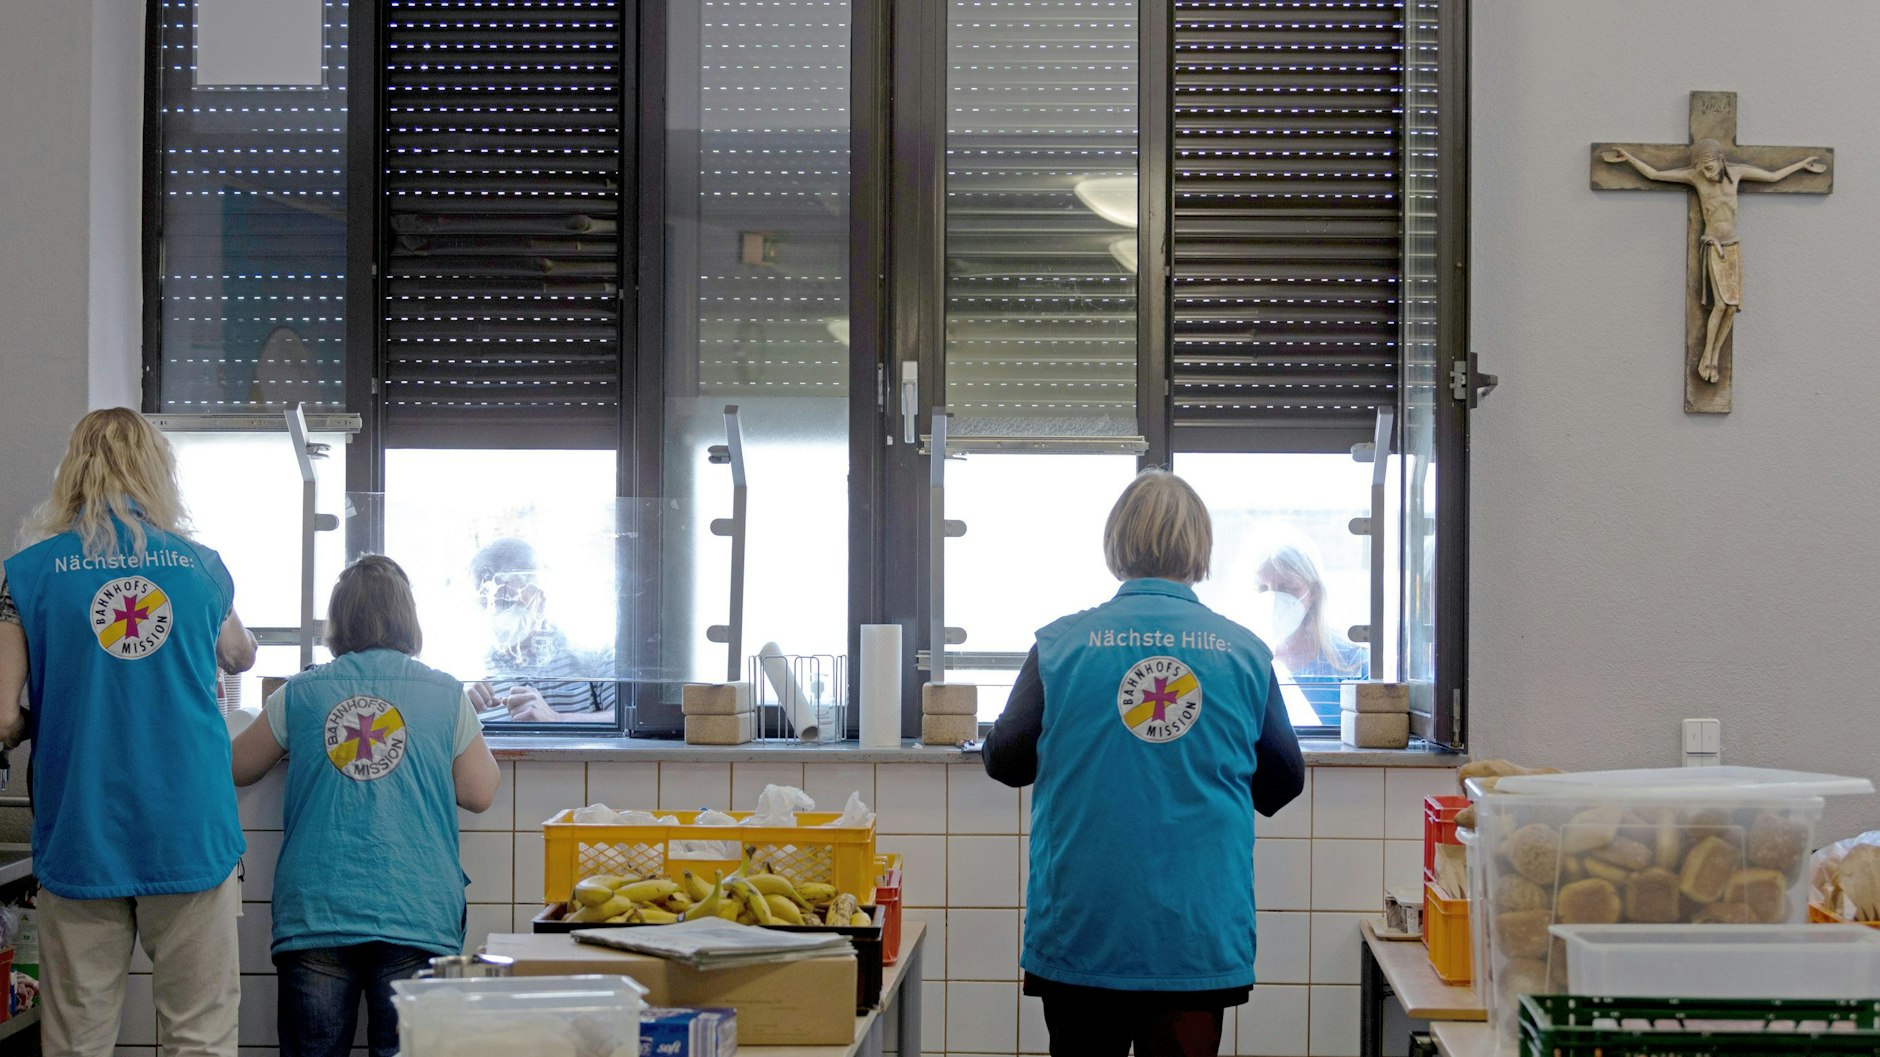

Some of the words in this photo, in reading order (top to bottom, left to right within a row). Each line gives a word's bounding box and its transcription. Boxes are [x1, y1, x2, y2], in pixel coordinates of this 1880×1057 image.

[55, 553, 140, 573] Nächste
[146, 549, 195, 569] Hilfe:
[95, 580, 148, 625] BAHNHOFS
[121, 615, 168, 654] MISSION
[1088, 628, 1175, 647] Nächste
[1182, 631, 1232, 653] Hilfe:
[1123, 661, 1181, 705] BAHNHOFS
[327, 698, 387, 746] BAHNHOFS
[1146, 701, 1197, 738] MISSION
[353, 738, 404, 776] MISSION
